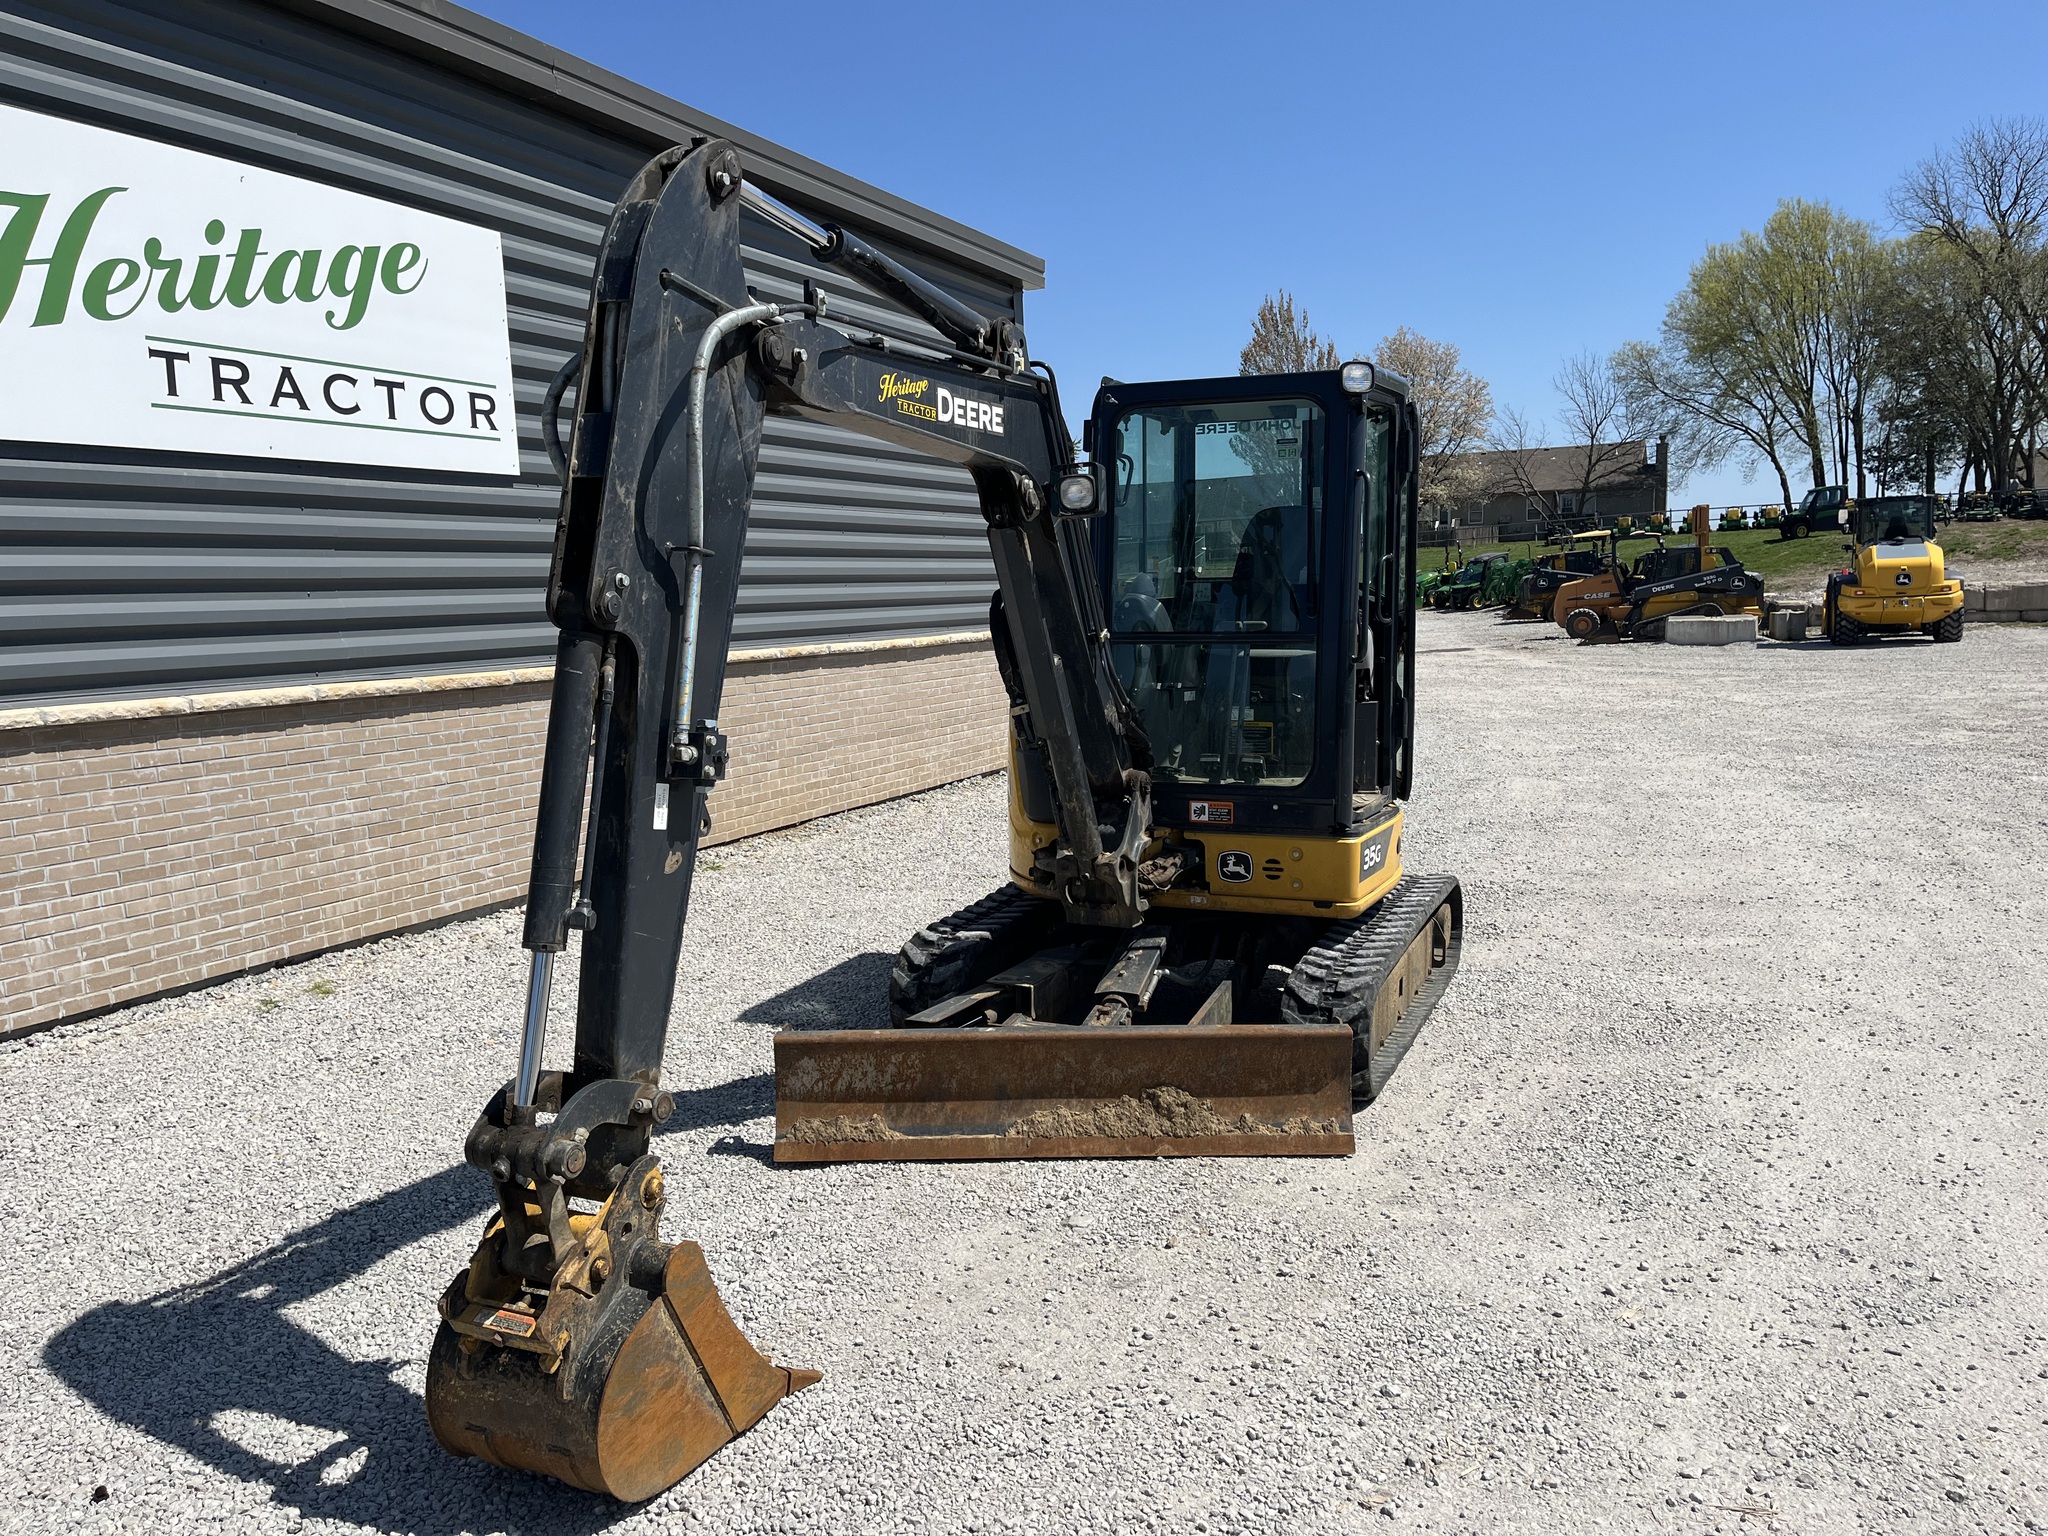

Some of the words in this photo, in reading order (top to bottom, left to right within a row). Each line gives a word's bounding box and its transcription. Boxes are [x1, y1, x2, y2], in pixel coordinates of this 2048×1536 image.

[0, 186, 428, 331] Heritage
[148, 346, 499, 431] TRACTOR
[878, 373, 929, 402] Heritage
[897, 401, 937, 419] TRACTOR
[937, 387, 1004, 434] DEERE
[1583, 592, 1611, 600] CASE
[1652, 583, 1675, 593] DEERE
[1363, 844, 1381, 871] 35G
